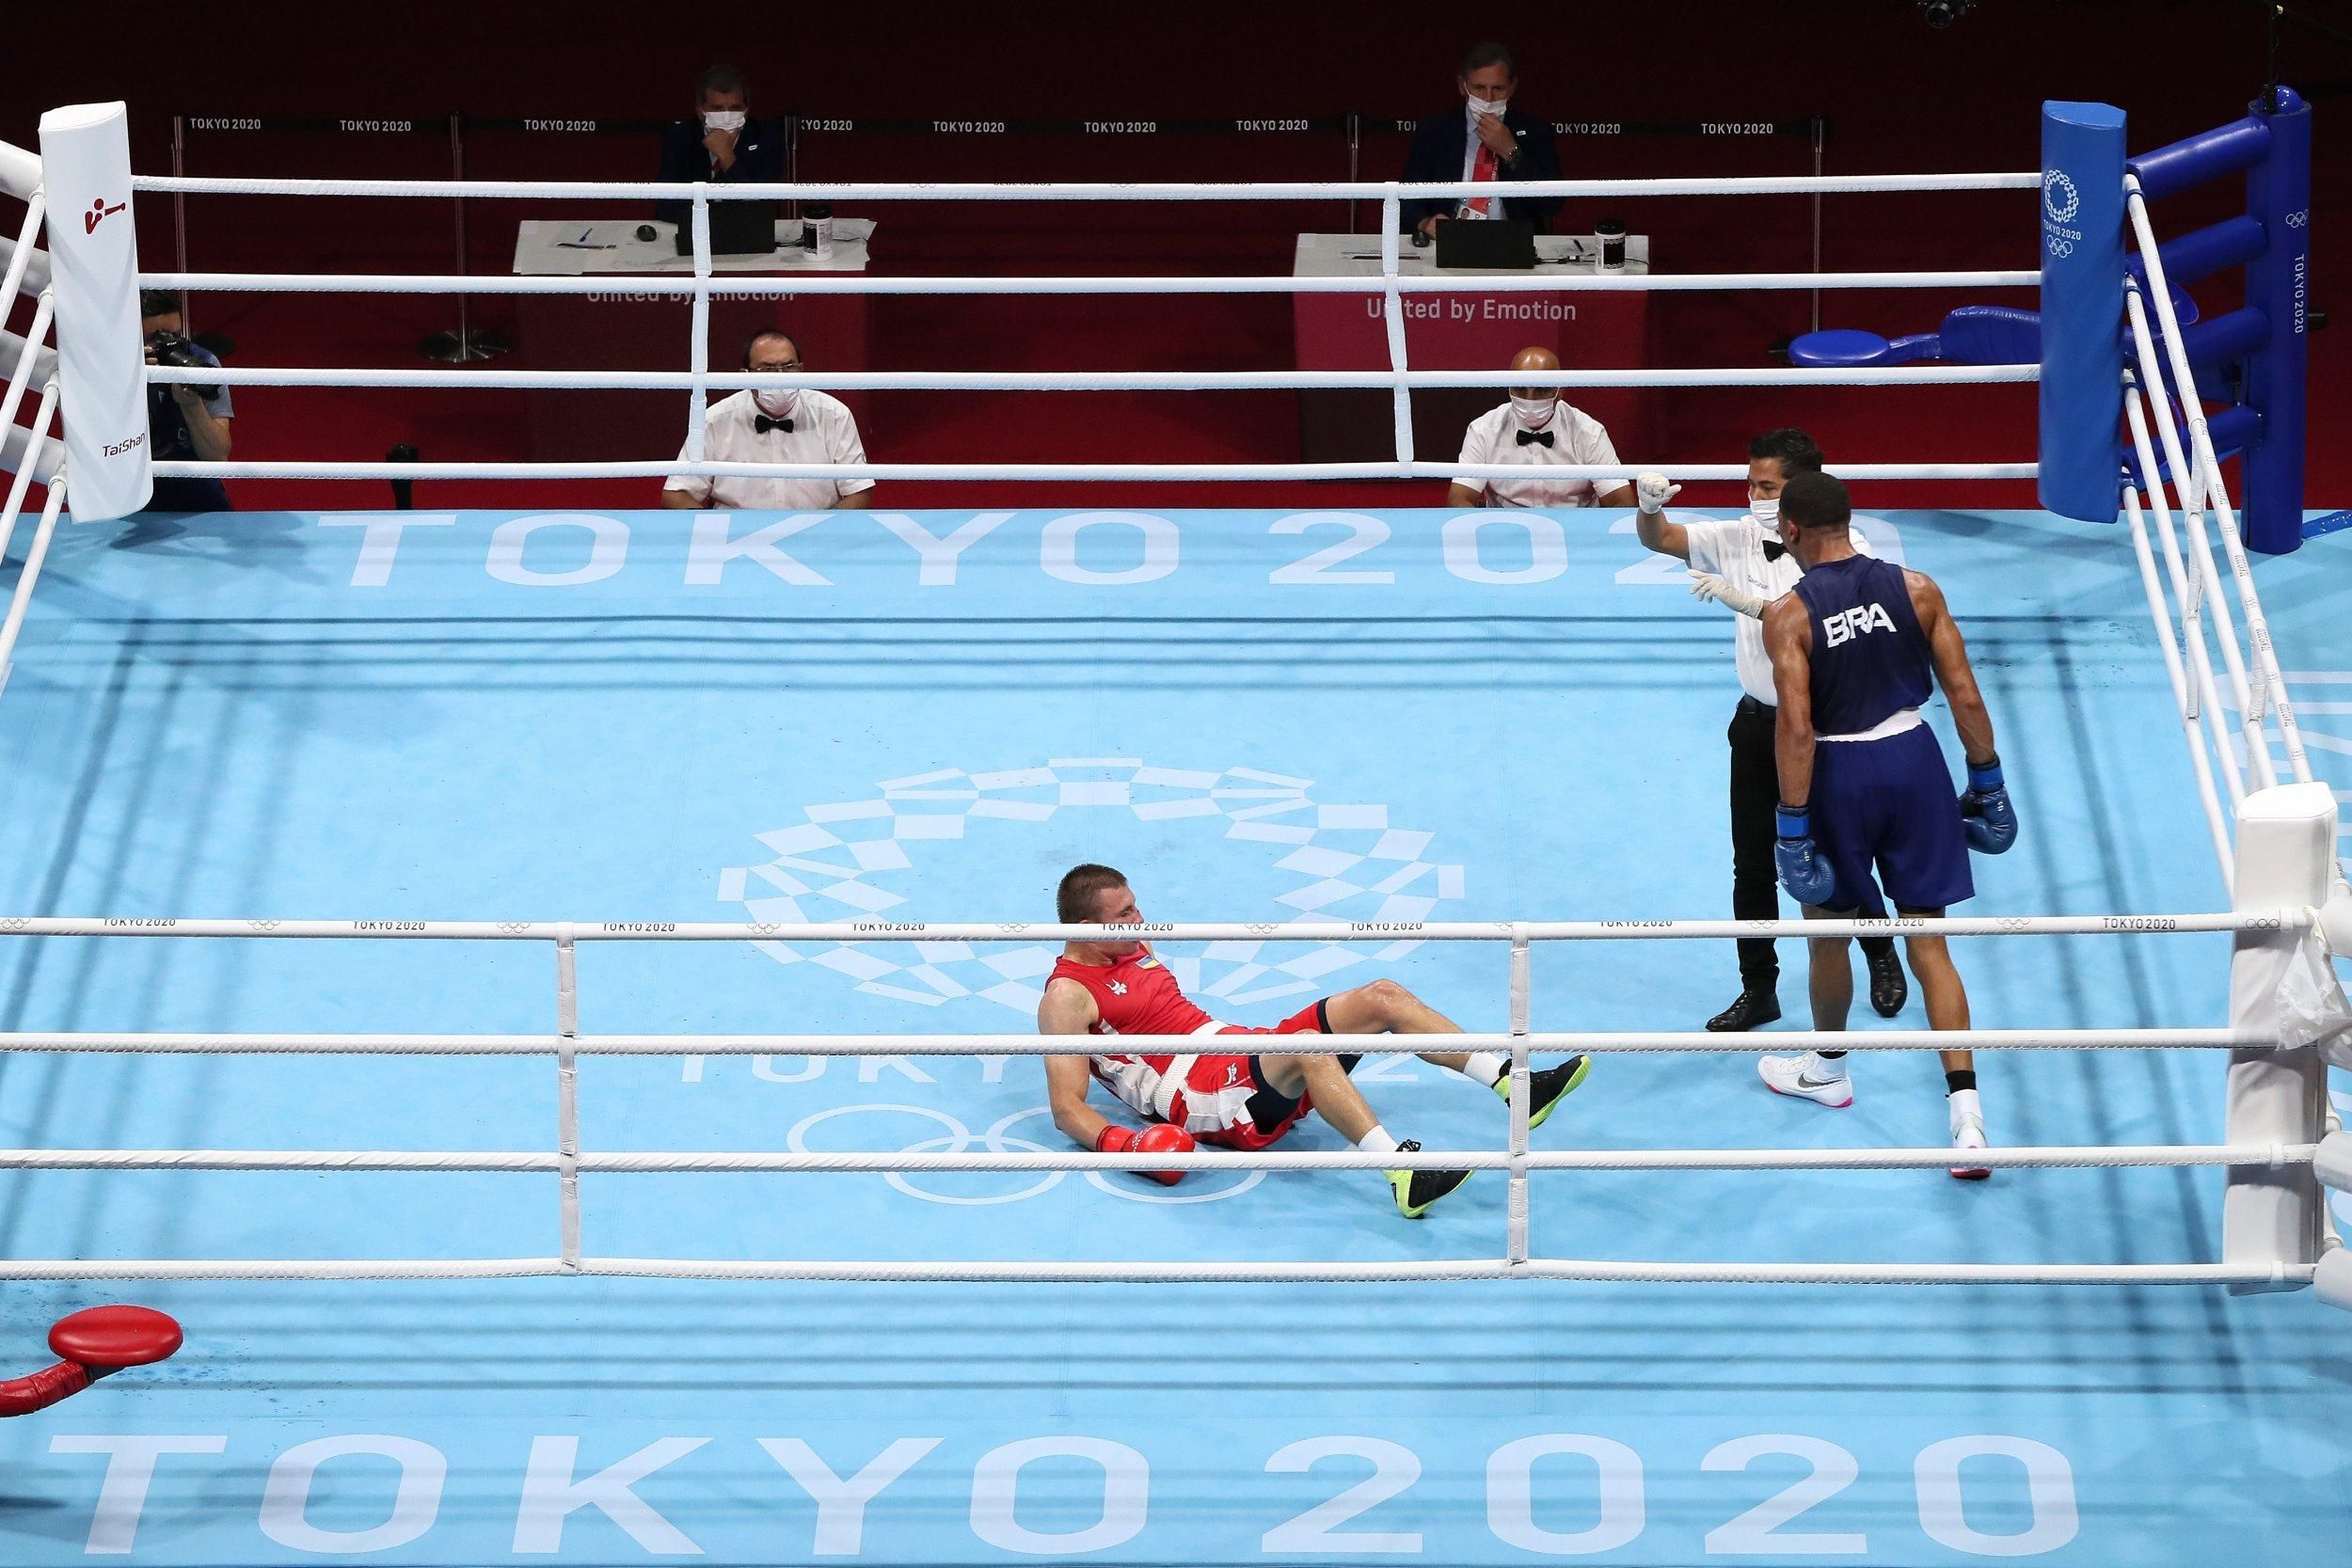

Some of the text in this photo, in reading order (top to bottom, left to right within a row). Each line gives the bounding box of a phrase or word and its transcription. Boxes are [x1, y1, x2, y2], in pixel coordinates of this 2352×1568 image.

[190, 118, 262, 130] TOKYO 2020
[340, 119, 411, 132] TOKYO 2020
[524, 119, 596, 132] TOKYO 2020
[823, 119, 852, 131] 2020
[932, 120, 1005, 134] TOKYO 2020
[1084, 121, 1157, 134] TOKYO 2020
[1236, 119, 1309, 132] TOKYO 2020
[1551, 122, 1621, 135] OKYO 2020
[1701, 122, 1773, 135] TOKYO 2020
[2061, 228, 2082, 241] 2020
[2295, 253, 2305, 334] TOKYO 2020
[1367, 298, 1577, 323] Uted by Emotion
[103, 433, 146, 457] TaiShan
[318, 512, 1180, 587] TOKYO
[1822, 602, 1898, 649] BRA
[2103, 917, 2176, 930] TOKYO 2020
[47, 1433, 2080, 1557] TOKYO 2020
